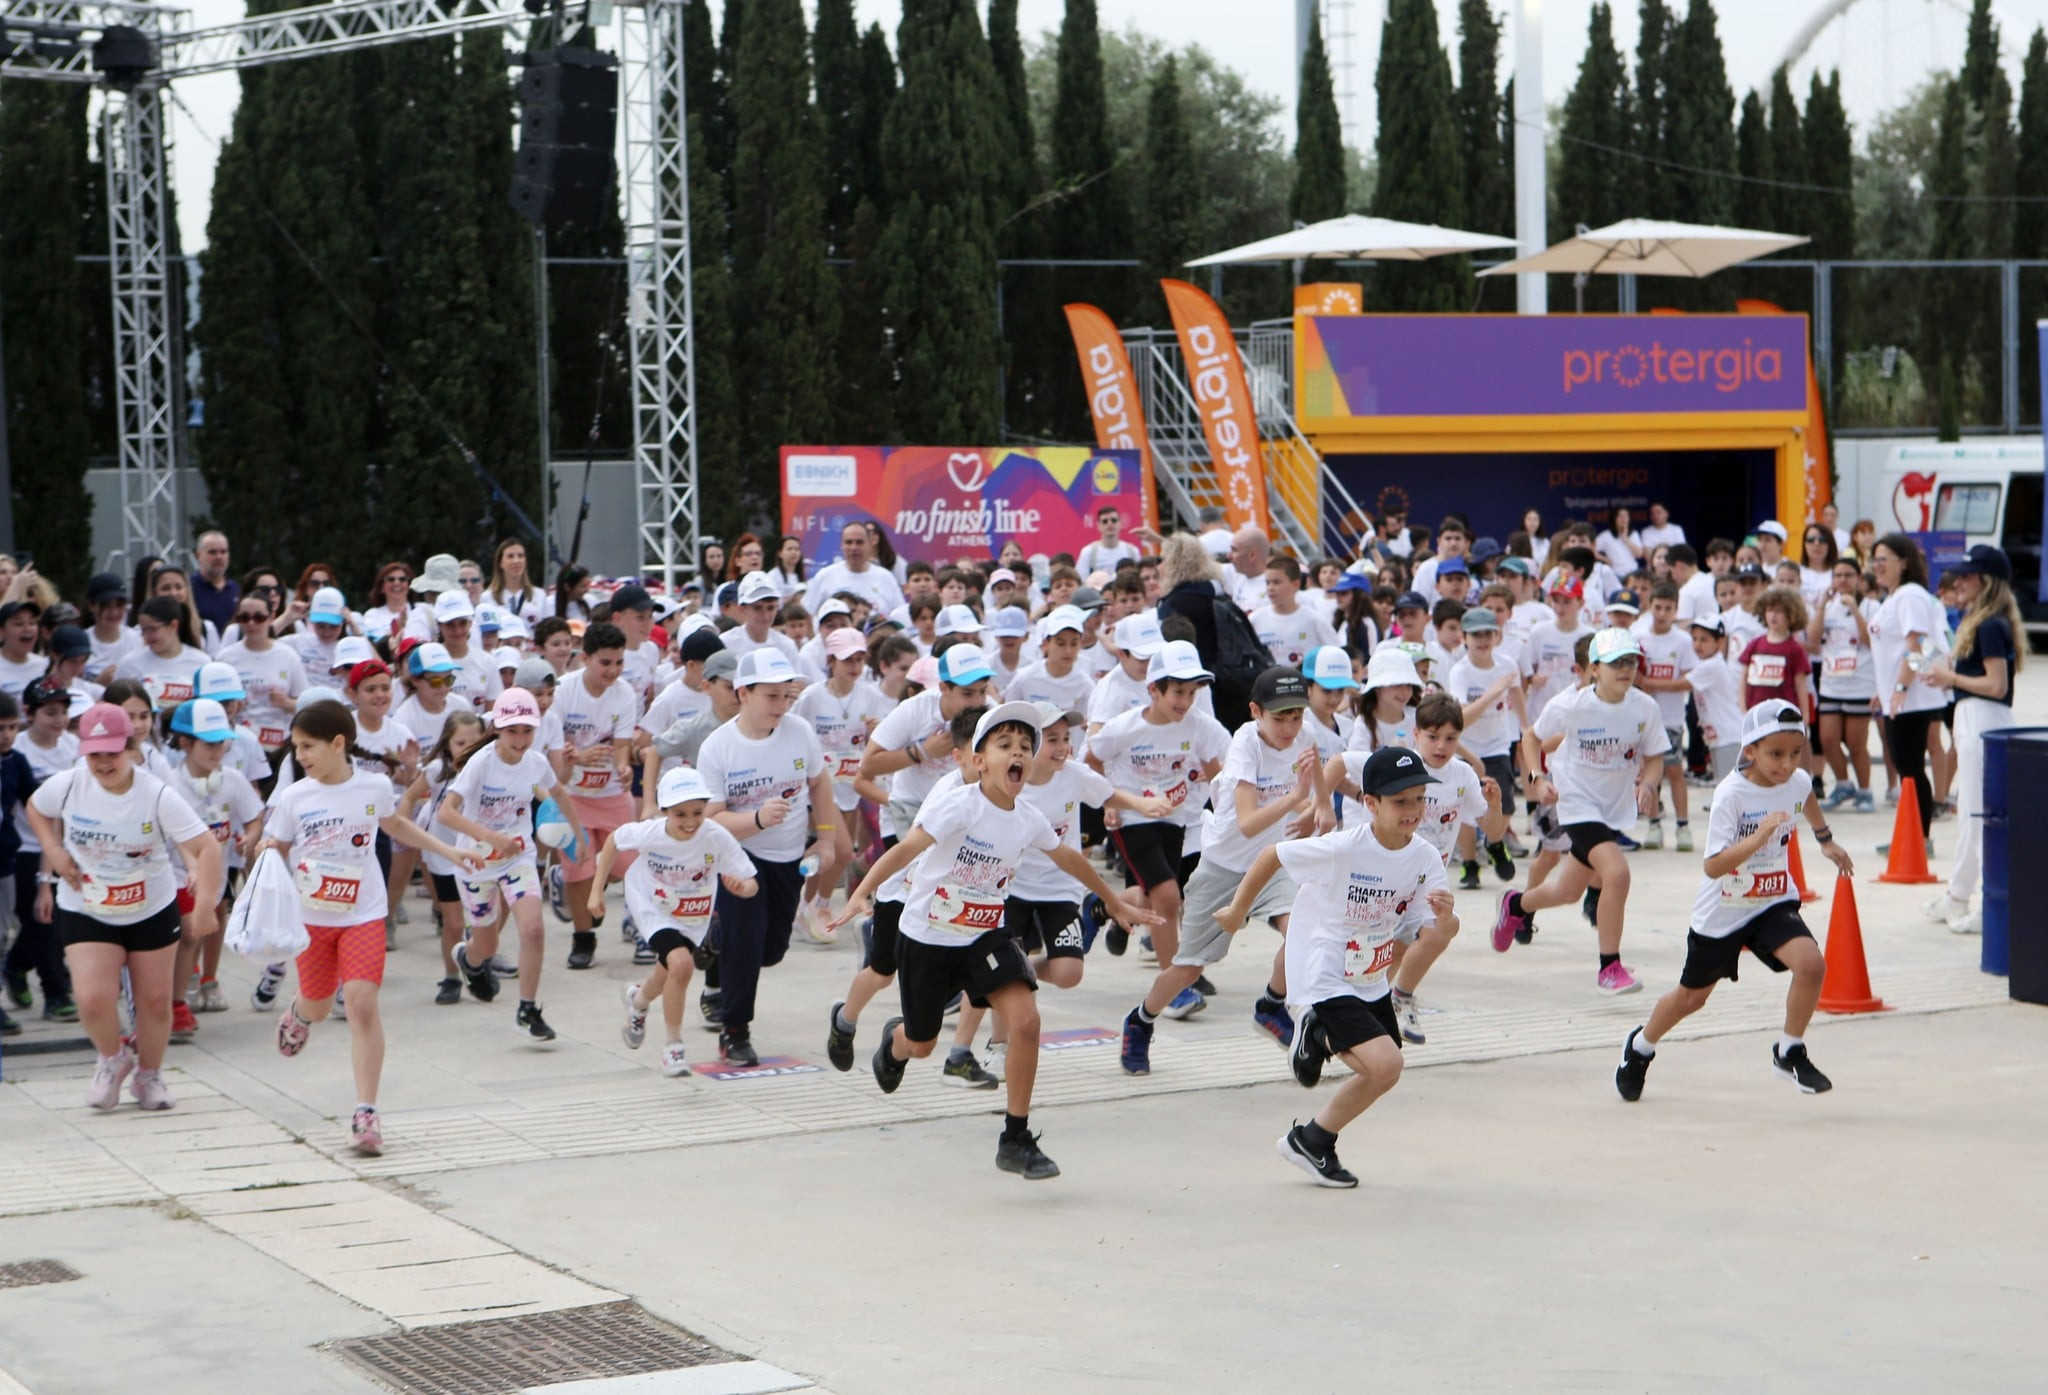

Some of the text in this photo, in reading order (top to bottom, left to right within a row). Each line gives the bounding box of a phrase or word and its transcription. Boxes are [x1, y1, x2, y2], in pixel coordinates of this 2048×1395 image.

[1563, 338, 1783, 393] protergia
[894, 498, 1041, 543] no finish line
[947, 534, 992, 547] ATHENS
[727, 776, 774, 791] CHARITY
[728, 789, 749, 798] RUN
[956, 853, 977, 867] RUN
[959, 846, 1004, 866] CHARITY
[647, 860, 685, 872] CHARITY
[1350, 873, 1382, 883] ΕΘΝΙΚΗ
[1757, 875, 1786, 890] 3037
[323, 881, 356, 897] 3074
[1348, 885, 1396, 898] CHARITY
[1347, 893, 1368, 904] RUN
[681, 900, 710, 913] 3049
[965, 908, 998, 922] 3075
